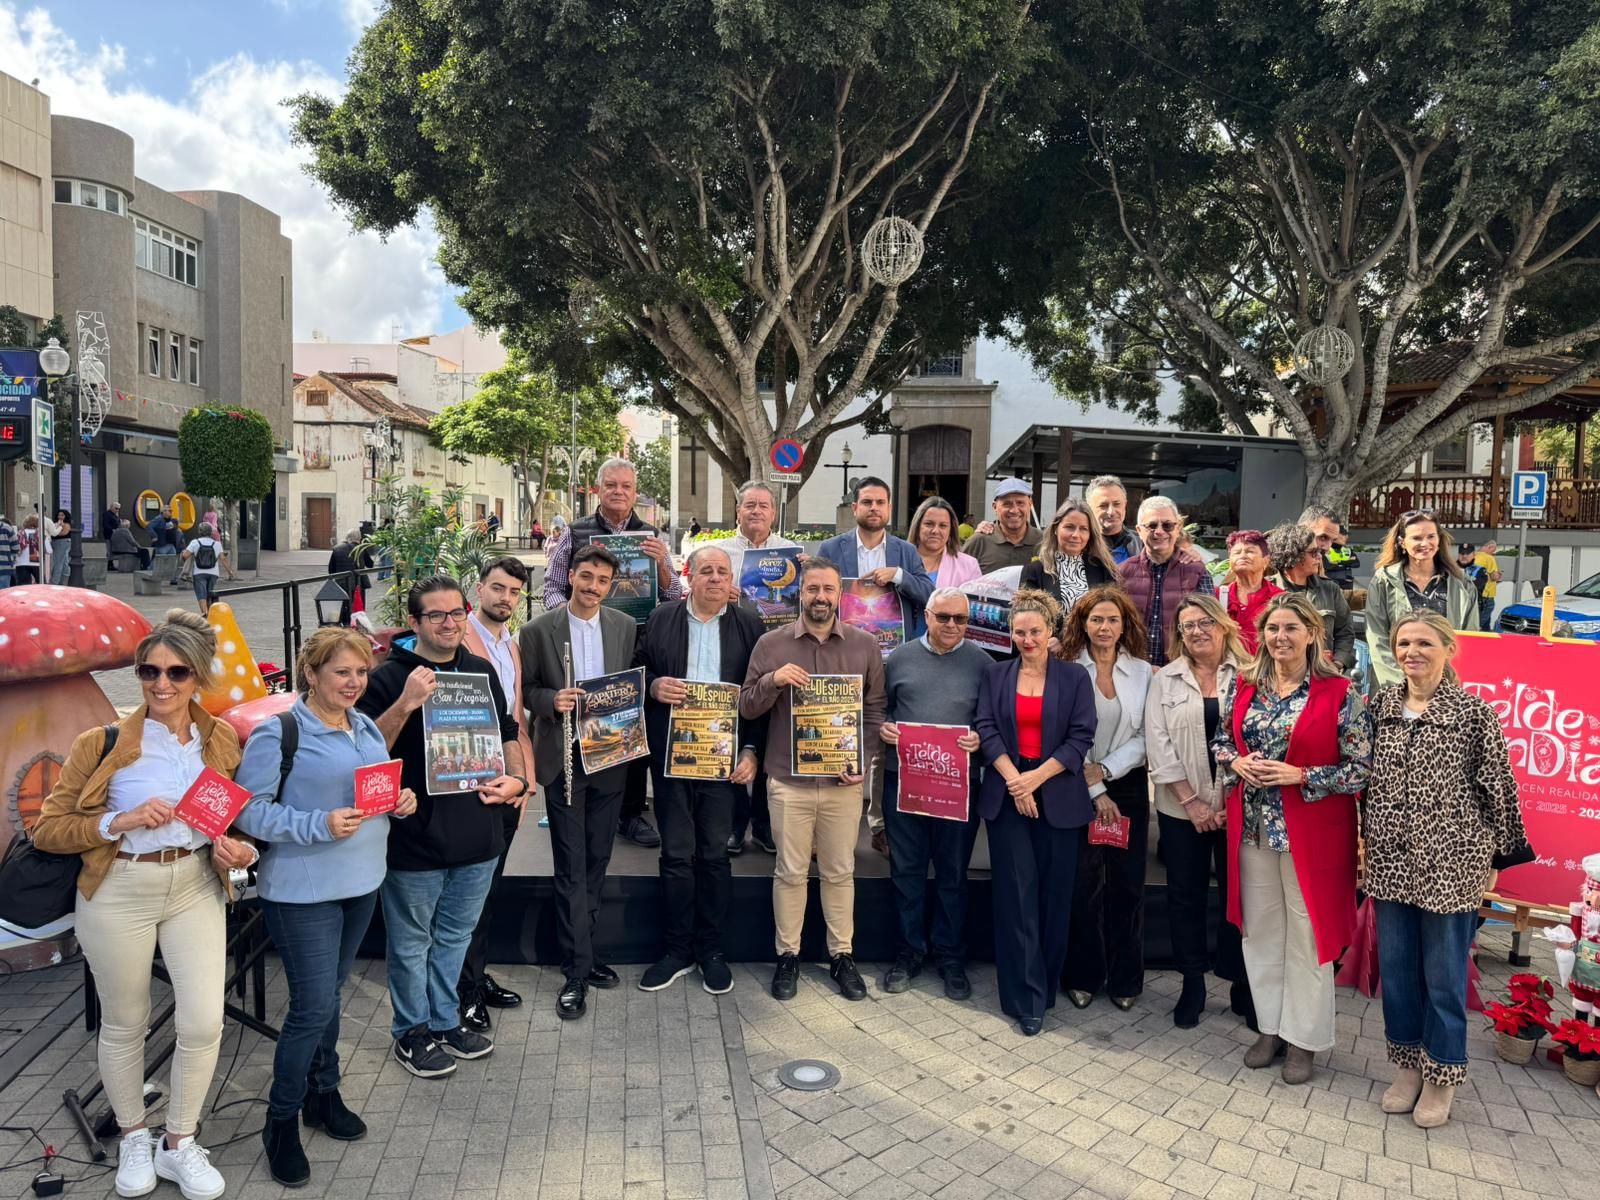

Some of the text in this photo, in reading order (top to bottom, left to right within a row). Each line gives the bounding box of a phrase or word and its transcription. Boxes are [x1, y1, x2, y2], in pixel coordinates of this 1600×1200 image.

[1518, 475, 1540, 504] P
[432, 688, 489, 705] San Gregorio
[1462, 681, 1585, 739] Telde
[909, 743, 951, 763] Telde
